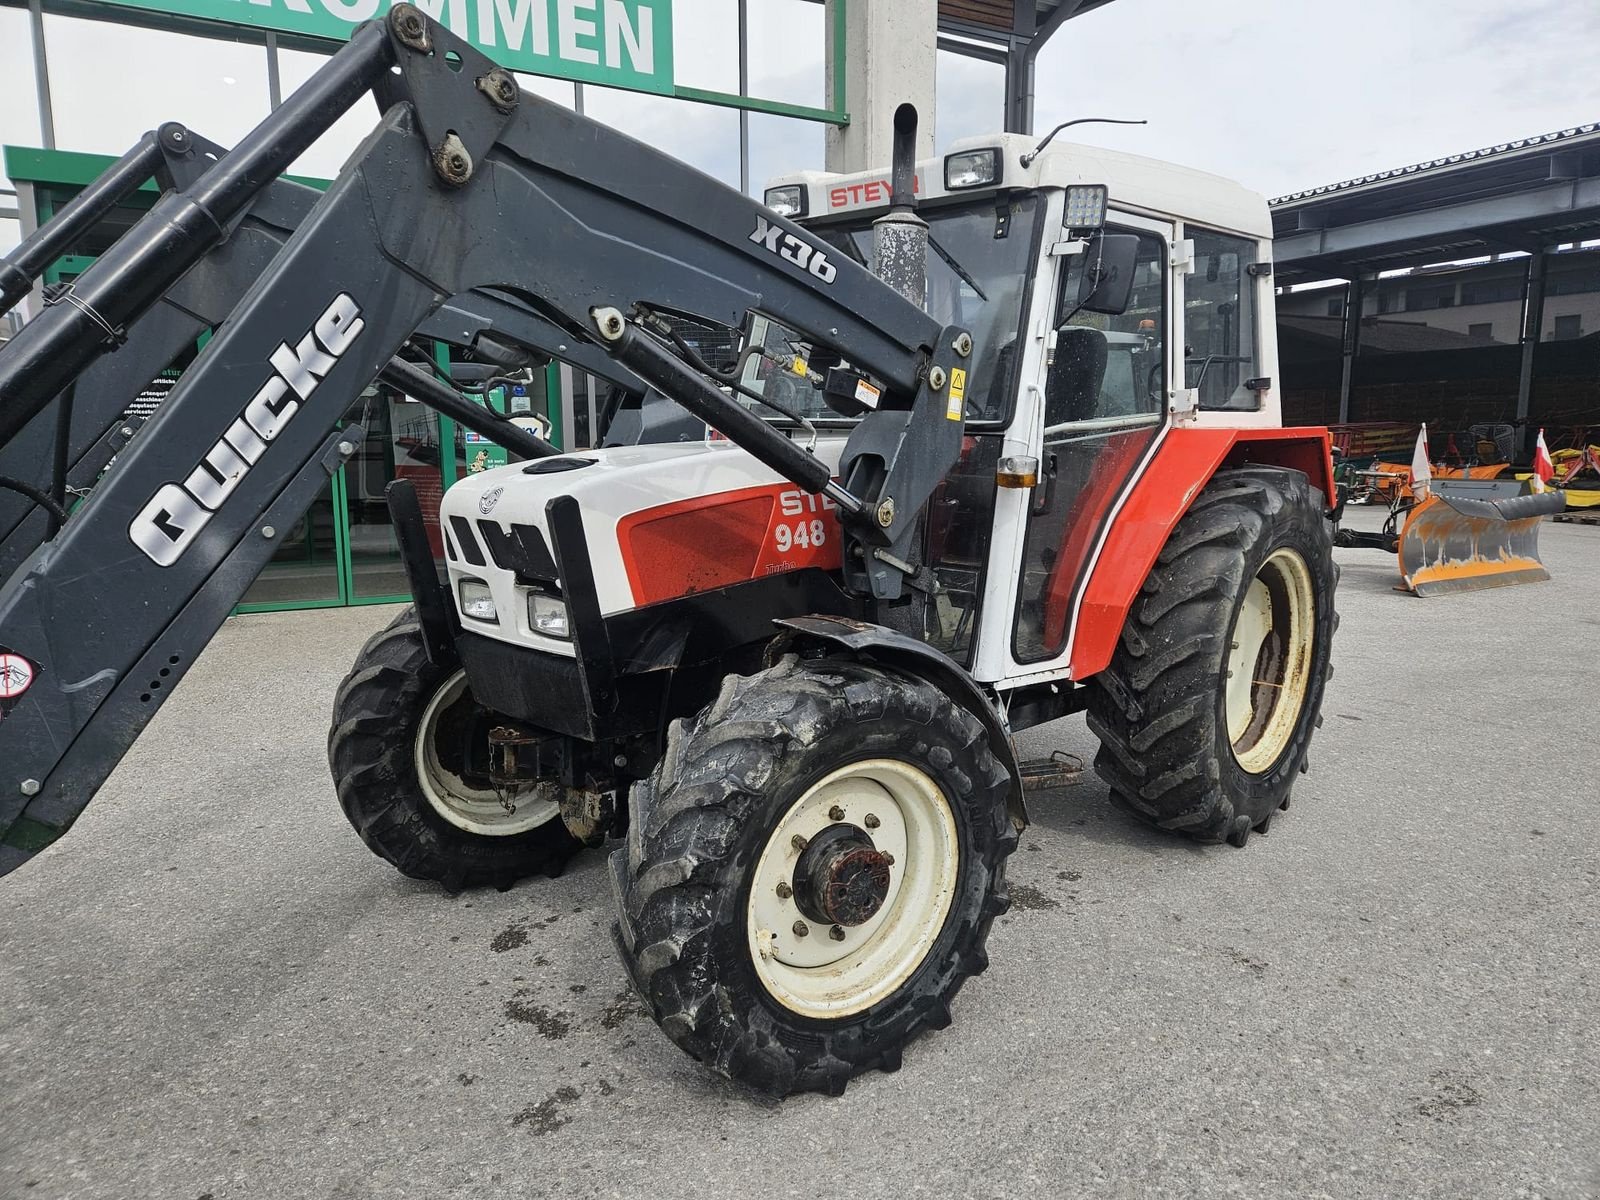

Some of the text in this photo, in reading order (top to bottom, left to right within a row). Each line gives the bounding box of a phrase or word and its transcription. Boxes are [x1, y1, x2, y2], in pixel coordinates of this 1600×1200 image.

[830, 175, 919, 208] STEY
[749, 215, 837, 284] X36
[129, 293, 365, 567] Quicke
[775, 519, 826, 552] 948
